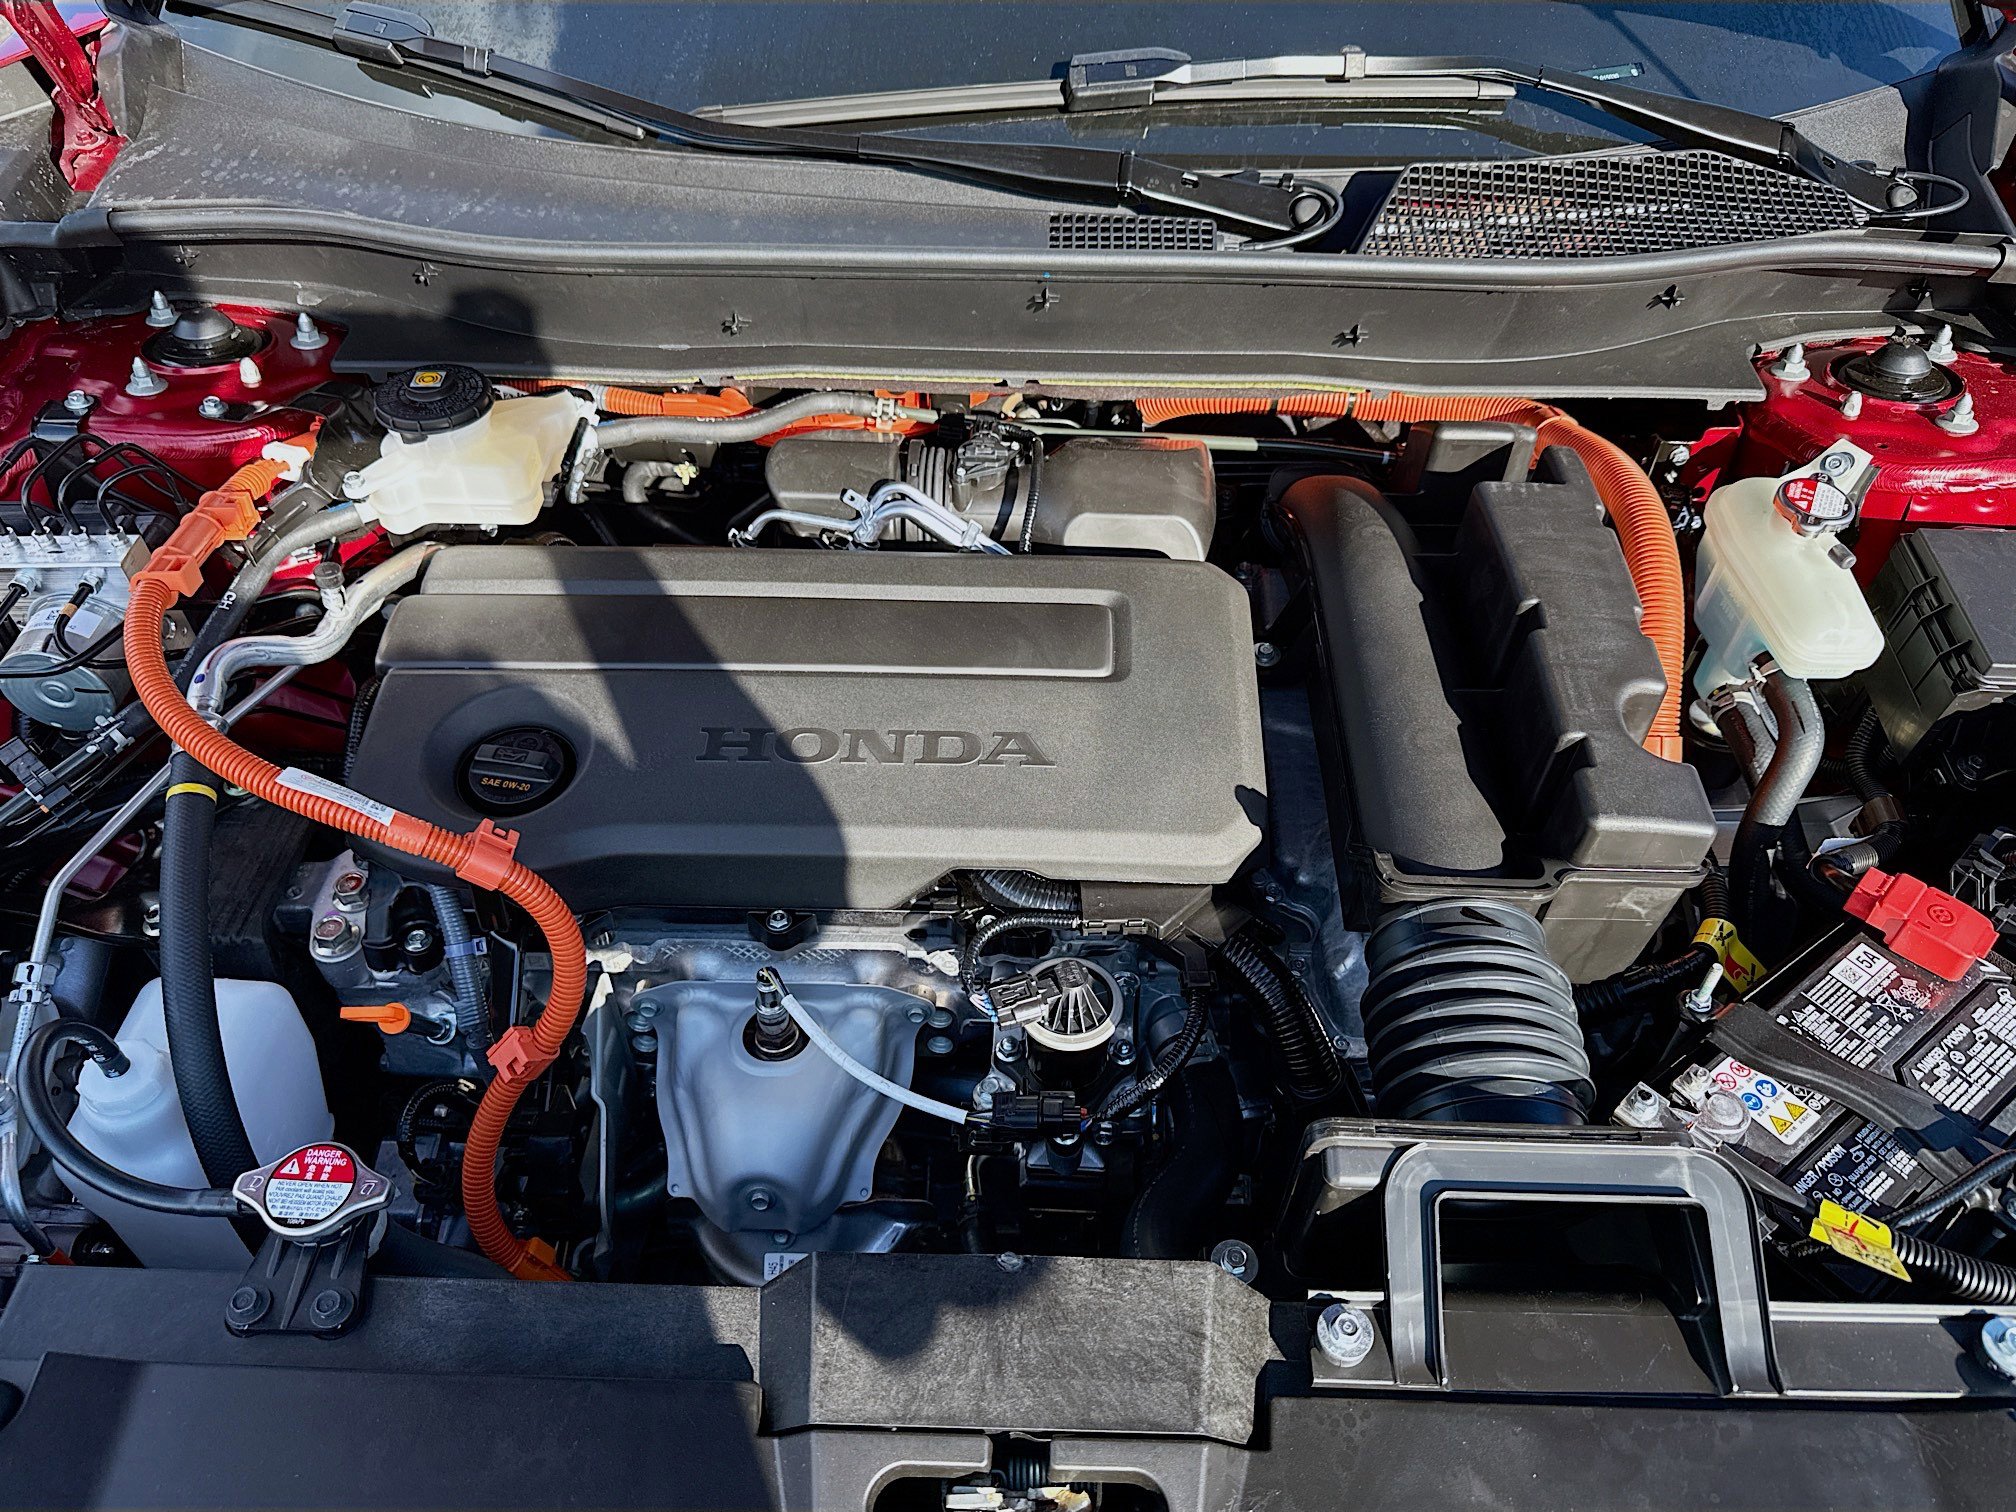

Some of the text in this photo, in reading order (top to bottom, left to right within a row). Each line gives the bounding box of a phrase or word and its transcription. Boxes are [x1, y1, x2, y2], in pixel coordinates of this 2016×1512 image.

[695, 727, 1057, 768] HONDA
[481, 777, 531, 791] SAE 0W-20
[1855, 950, 1880, 969] 5A
[306, 1149, 342, 1158] DANGER
[304, 1157, 347, 1166] WARNUNG
